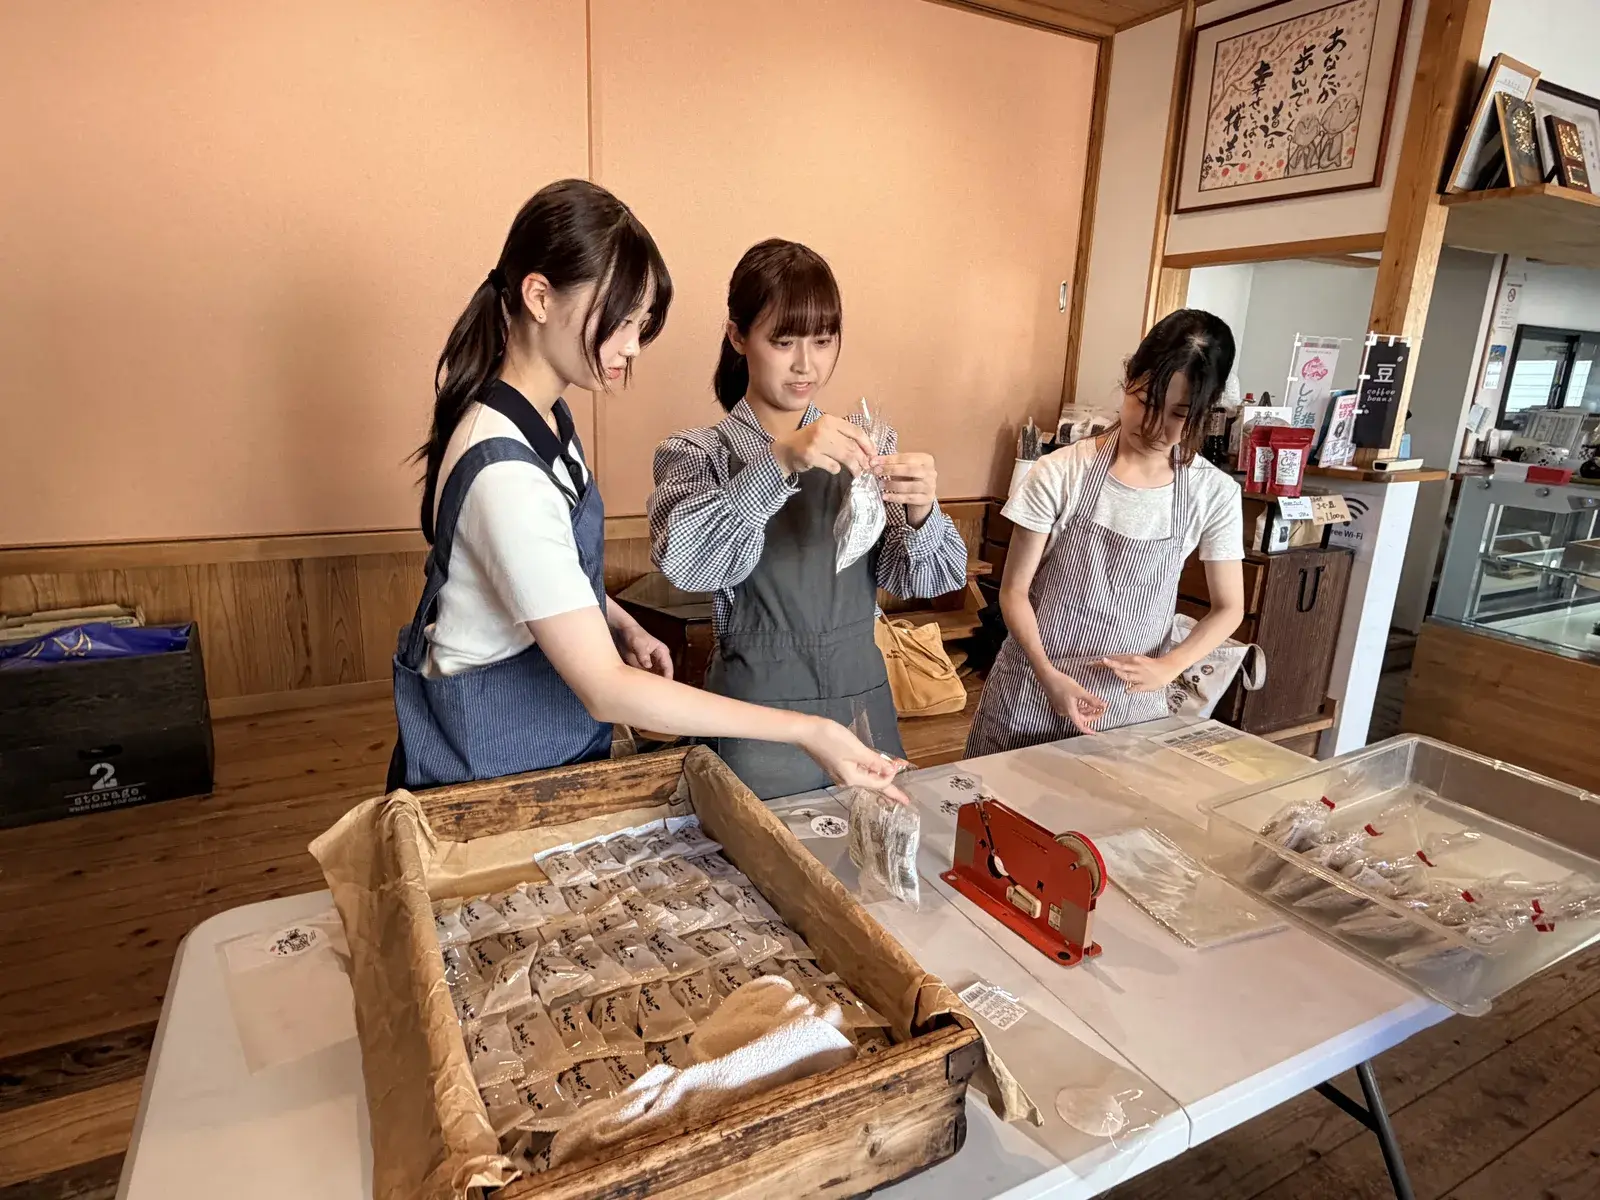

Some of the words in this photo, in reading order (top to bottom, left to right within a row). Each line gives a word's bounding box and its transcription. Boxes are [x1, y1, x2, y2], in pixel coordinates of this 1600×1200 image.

[1286, 44, 1316, 132] 歩んでいく
[1242, 60, 1273, 159] 幸せいっぱいの
[1259, 100, 1288, 149] 道は
[1373, 363, 1397, 383] 豆
[1366, 387, 1396, 397] coffee
[1366, 395, 1393, 403] beans
[1330, 529, 1343, 537] ree
[1344, 529, 1364, 541] Wi-Fi
[89, 762, 118, 790] 2
[74, 788, 139, 806] storage
